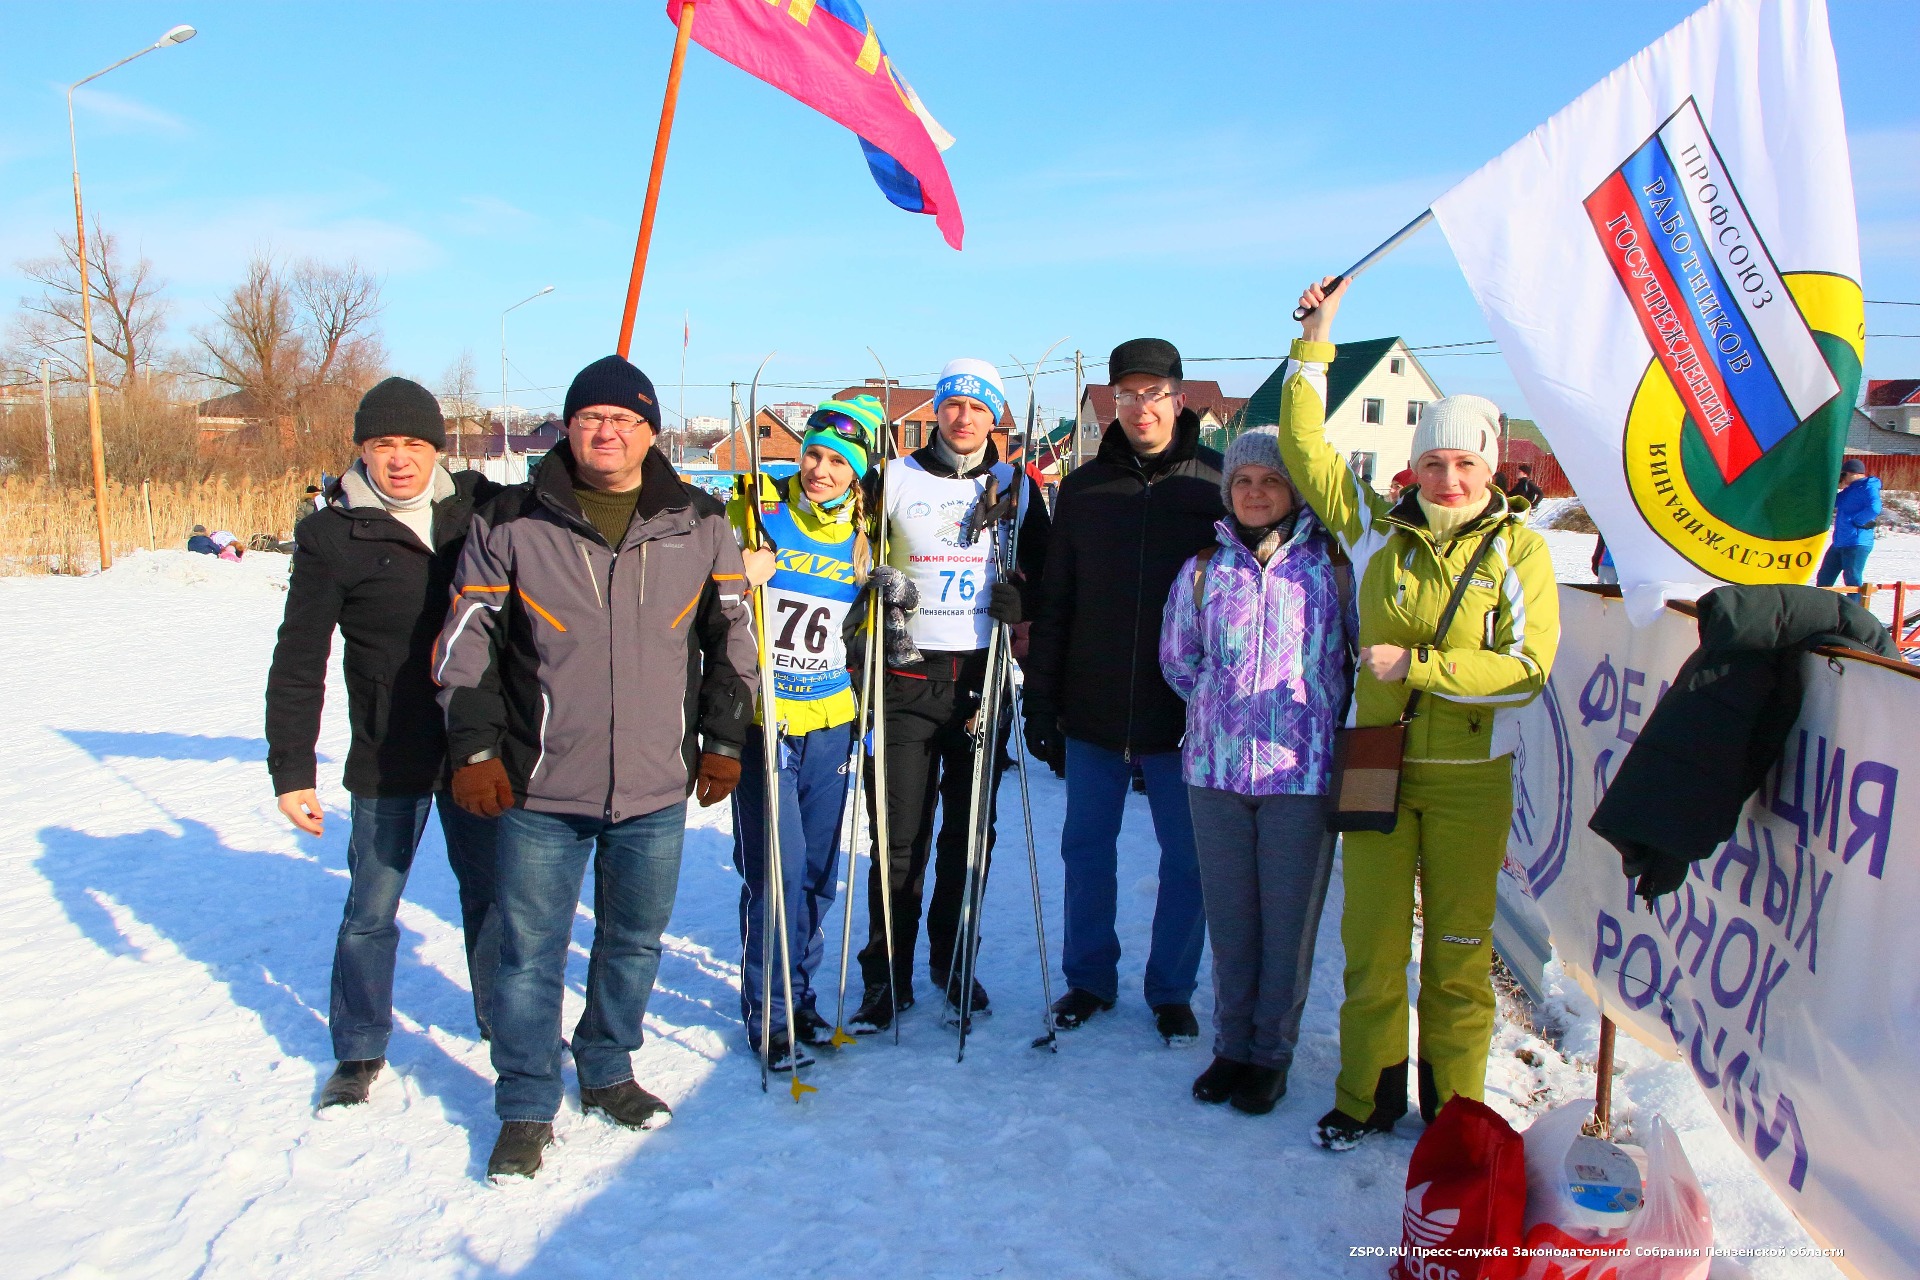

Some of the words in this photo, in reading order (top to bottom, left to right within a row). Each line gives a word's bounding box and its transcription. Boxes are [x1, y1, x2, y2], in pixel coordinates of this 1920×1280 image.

[1680, 142, 1774, 310] ПРОФСОЮЗ
[1643, 175, 1753, 376] РАБОТНИКОВ
[1605, 210, 1735, 437] ГОСУЧРЕЖДЕНИЙ
[1648, 441, 1813, 571] ОБСЛУЖИВАНИЯ
[909, 555, 945, 563] ЛЫЖНЯ
[947, 555, 983, 563] РОССИИ
[939, 569, 975, 603] 76
[774, 600, 831, 654] 76
[919, 607, 965, 616] Пензенская
[771, 652, 829, 671] ENZA
[777, 682, 813, 693] X-LIFE
[1442, 935, 1482, 945] SPYDER
